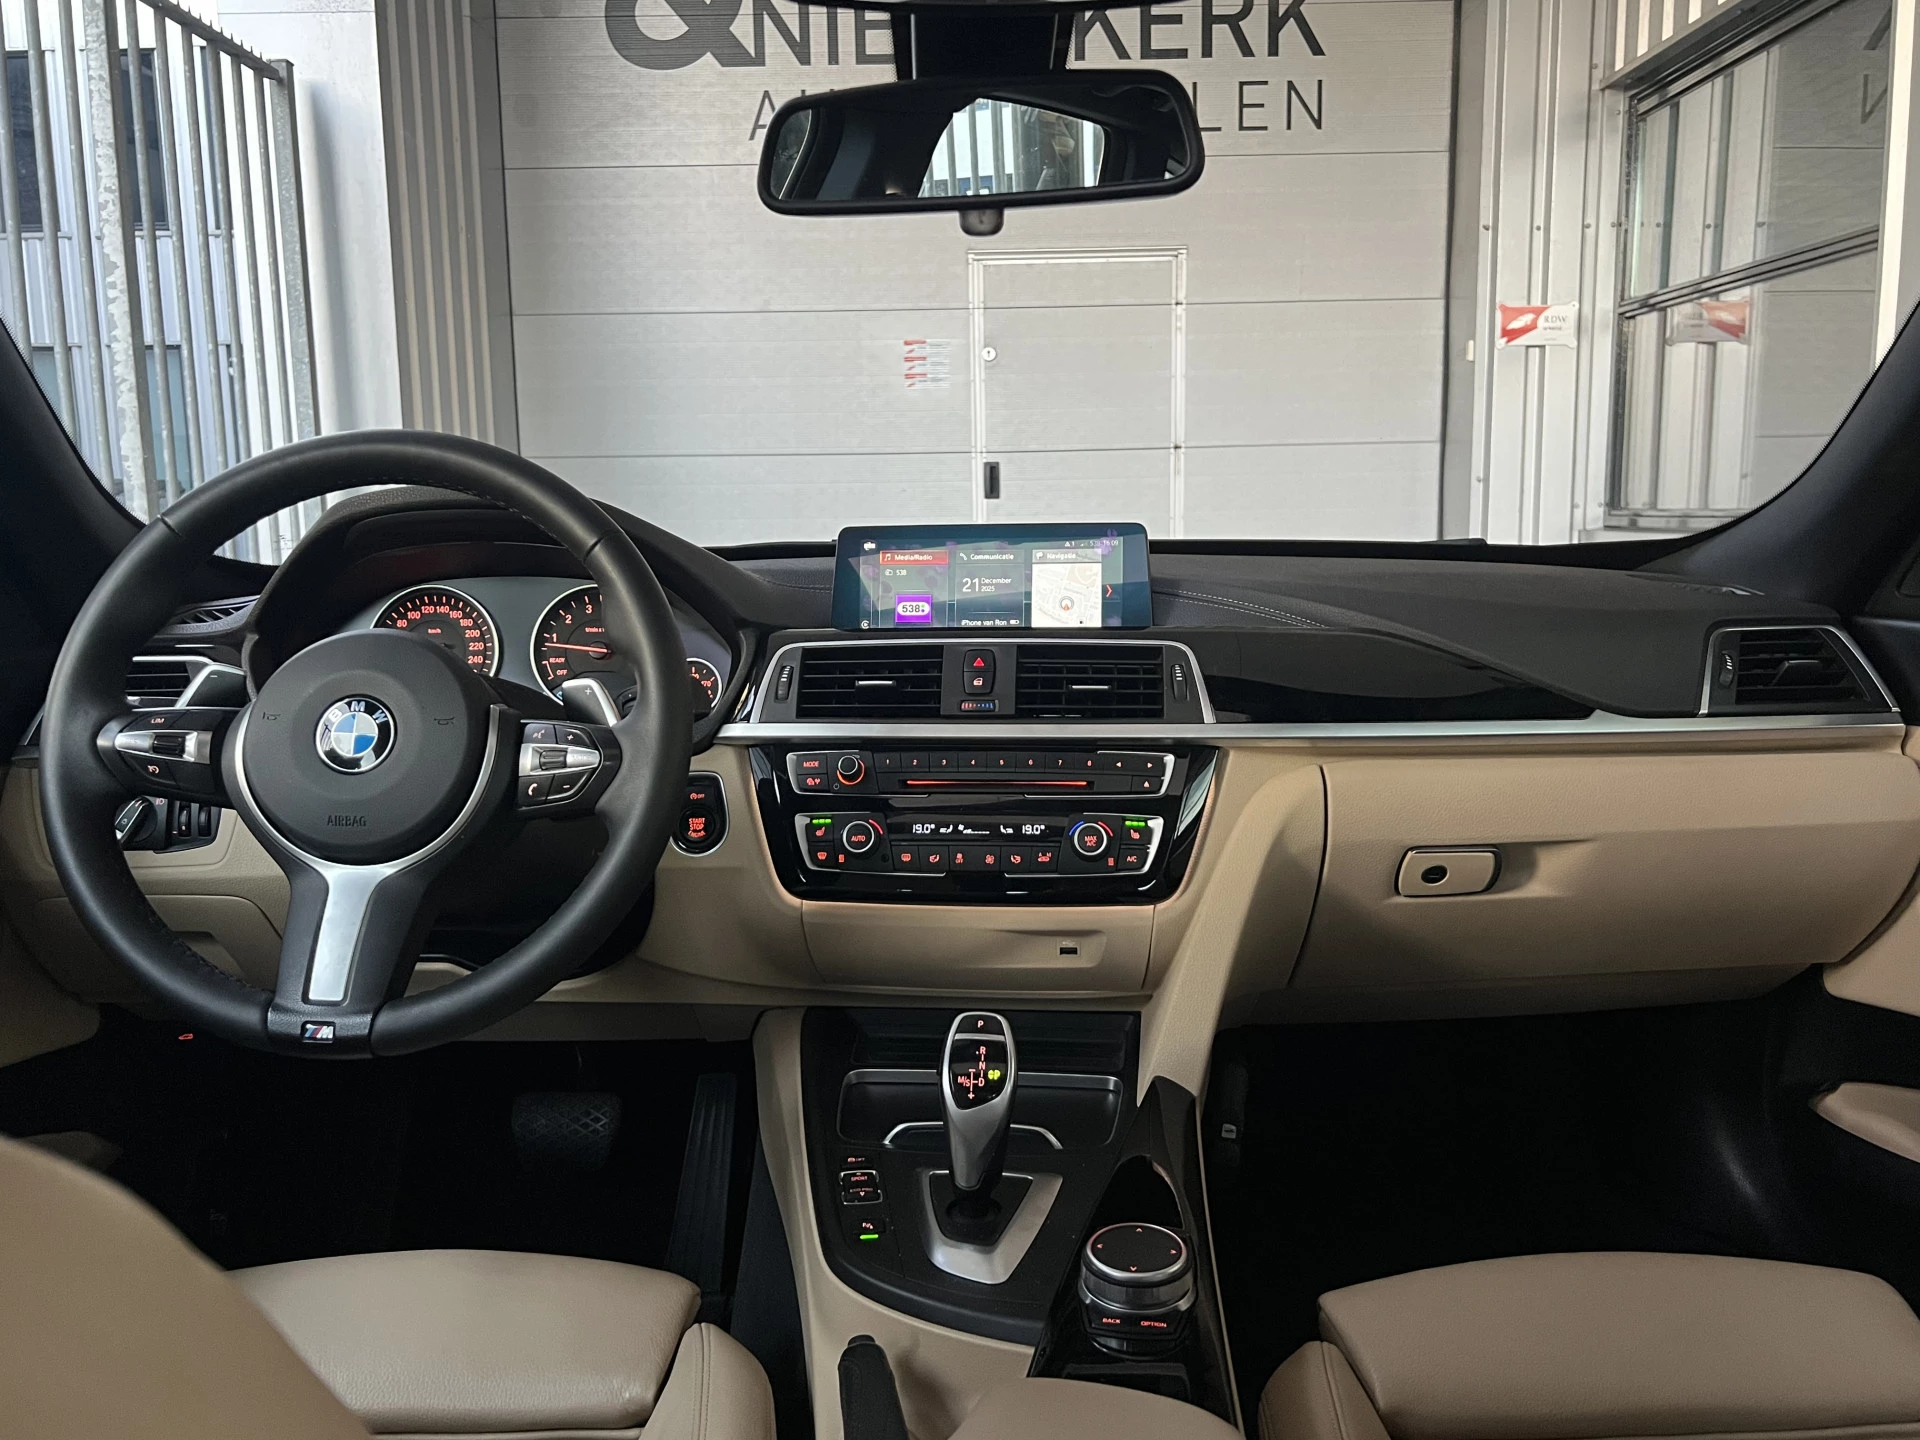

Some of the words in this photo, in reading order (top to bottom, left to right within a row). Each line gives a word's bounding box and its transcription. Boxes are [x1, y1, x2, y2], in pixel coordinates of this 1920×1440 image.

[1543, 314, 1568, 324] RDW
[1046, 552, 1076, 560] Navigatie
[962, 577, 980, 592] 21
[421, 605, 434, 613] 120
[436, 605, 450, 613] 140
[585, 604, 592, 614] 3
[901, 604, 921, 613] 538
[407, 611, 420, 620] 100
[449, 610, 462, 619] 160
[565, 614, 572, 624] 2
[396, 619, 408, 628] 80
[460, 618, 473, 626] 180
[465, 629, 480, 638] 200
[552, 633, 557, 642] 1
[468, 641, 484, 650] 220
[467, 655, 483, 664] 240
[328, 701, 388, 724] BMW
[326, 815, 367, 827] AIRBAG
[689, 823, 704, 831] STOP
[1126, 855, 1138, 863] A/C
[977, 1020, 984, 1028] P
[980, 1047, 986, 1055] R
[979, 1062, 986, 1070] N
[978, 1078, 985, 1087] D
